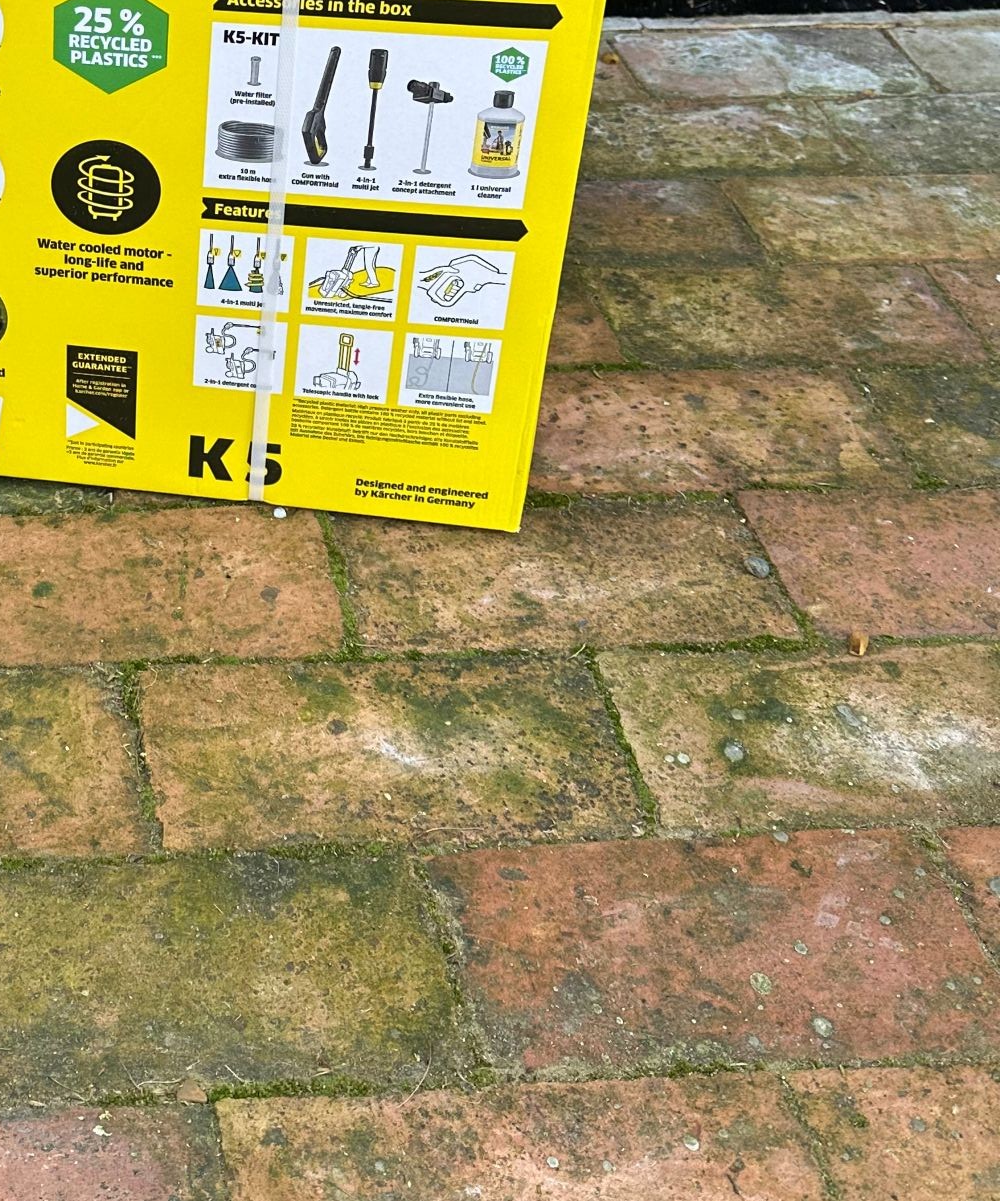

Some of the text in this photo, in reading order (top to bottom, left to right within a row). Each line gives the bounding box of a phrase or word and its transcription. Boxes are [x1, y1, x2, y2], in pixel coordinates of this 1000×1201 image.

[348, 0, 376, 14] the
[380, 0, 412, 17] box
[74, 6, 145, 36] 25 %
[68, 33, 152, 53] RECYCLED
[223, 30, 280, 46] K5-KIT
[495, 55, 516, 64] 100
[230, 99, 276, 107] (pre-installed)
[419, 181, 452, 189] detergent
[214, 203, 279, 219] Feature
[37, 238, 76, 252] Water
[79, 241, 121, 256] cooled
[123, 245, 164, 259] motor
[64, 254, 144, 271] long-life and
[34, 265, 174, 288] superior performance
[72, 361, 127, 373] GUARANTEE
[78, 353, 126, 364] EXTENDED
[355, 478, 488, 500] Designed and engineered
[354, 488, 475, 509] by Kärcher in Germany
